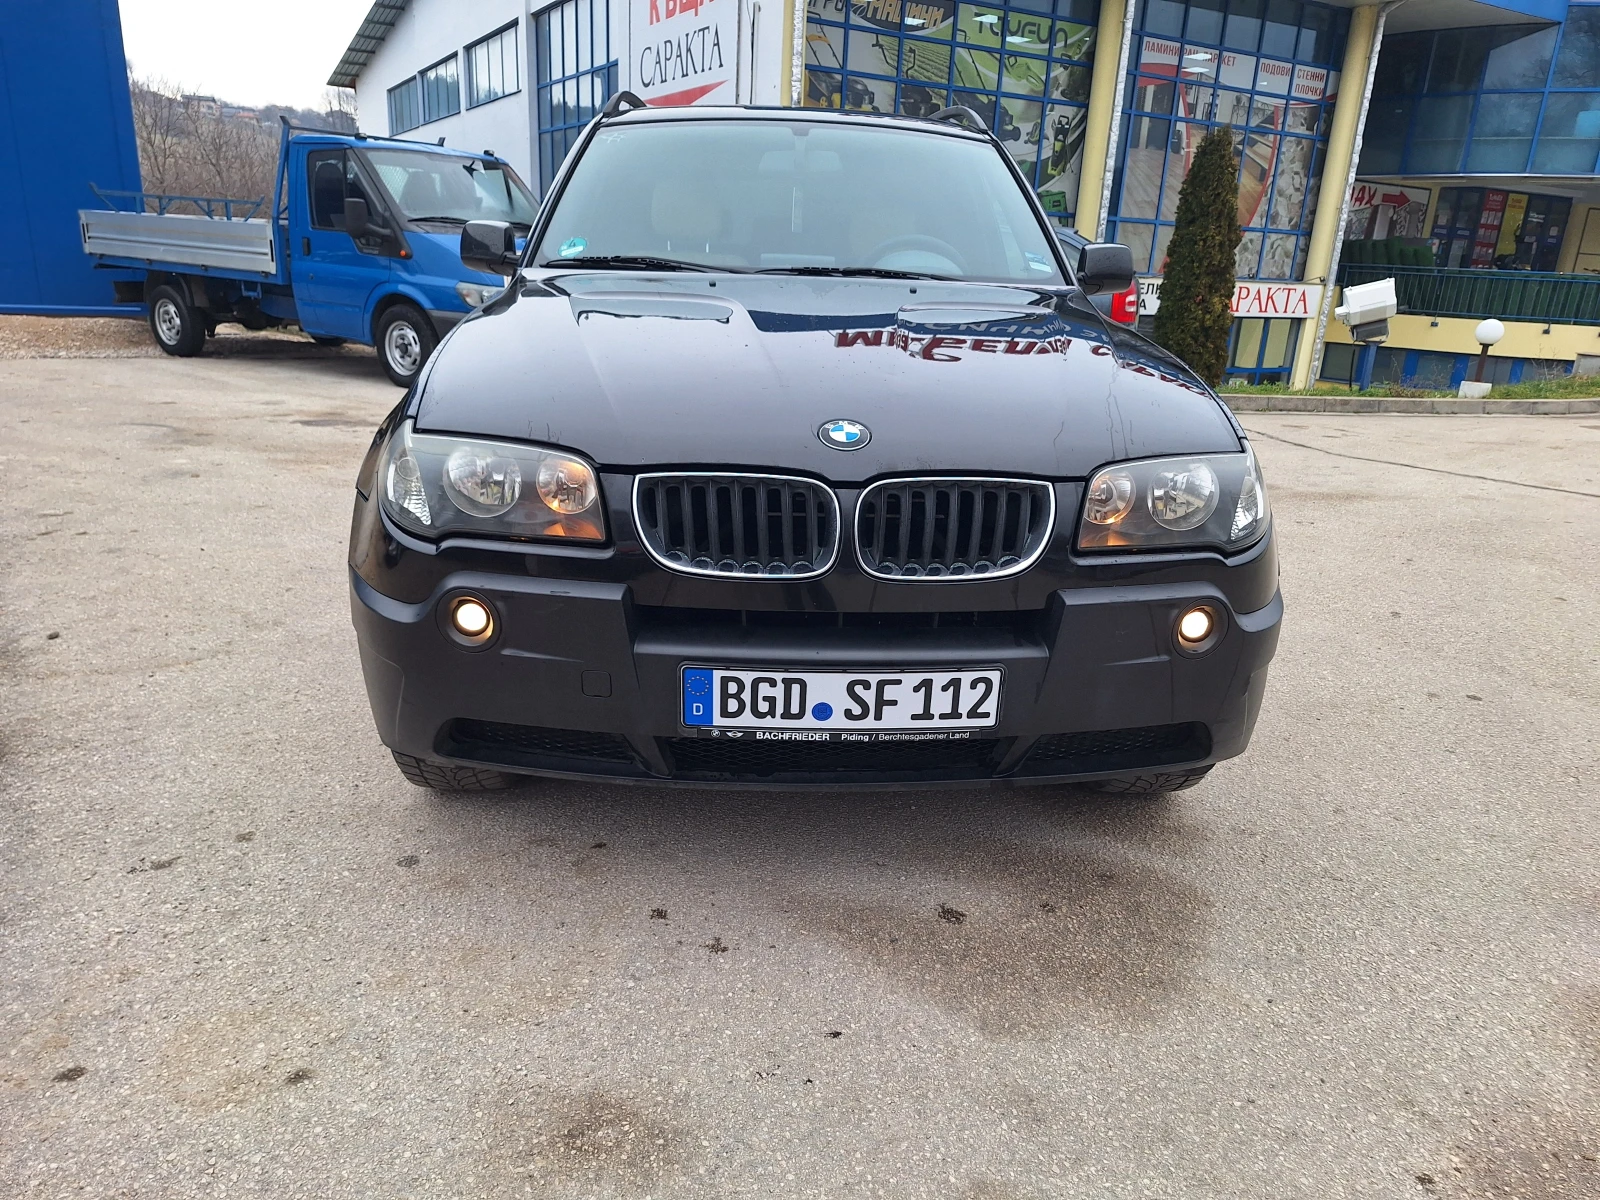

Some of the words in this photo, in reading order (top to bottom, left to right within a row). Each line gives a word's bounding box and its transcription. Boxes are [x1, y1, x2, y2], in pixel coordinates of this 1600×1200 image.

[640, 22, 724, 88] САРАКТА
[1260, 62, 1291, 77] ПОДОВИ
[1297, 68, 1325, 83] СТЕННИ
[1230, 286, 1308, 314] РАКТА
[720, 676, 807, 720] BGD
[844, 679, 903, 721] SF
[910, 677, 994, 721] 112
[693, 703, 703, 715] D
[756, 731, 830, 741] BACHFRIEDER
[841, 733, 869, 742] Piding
[878, 732, 948, 741] Berchtesgadener
[949, 731, 970, 739] Land
